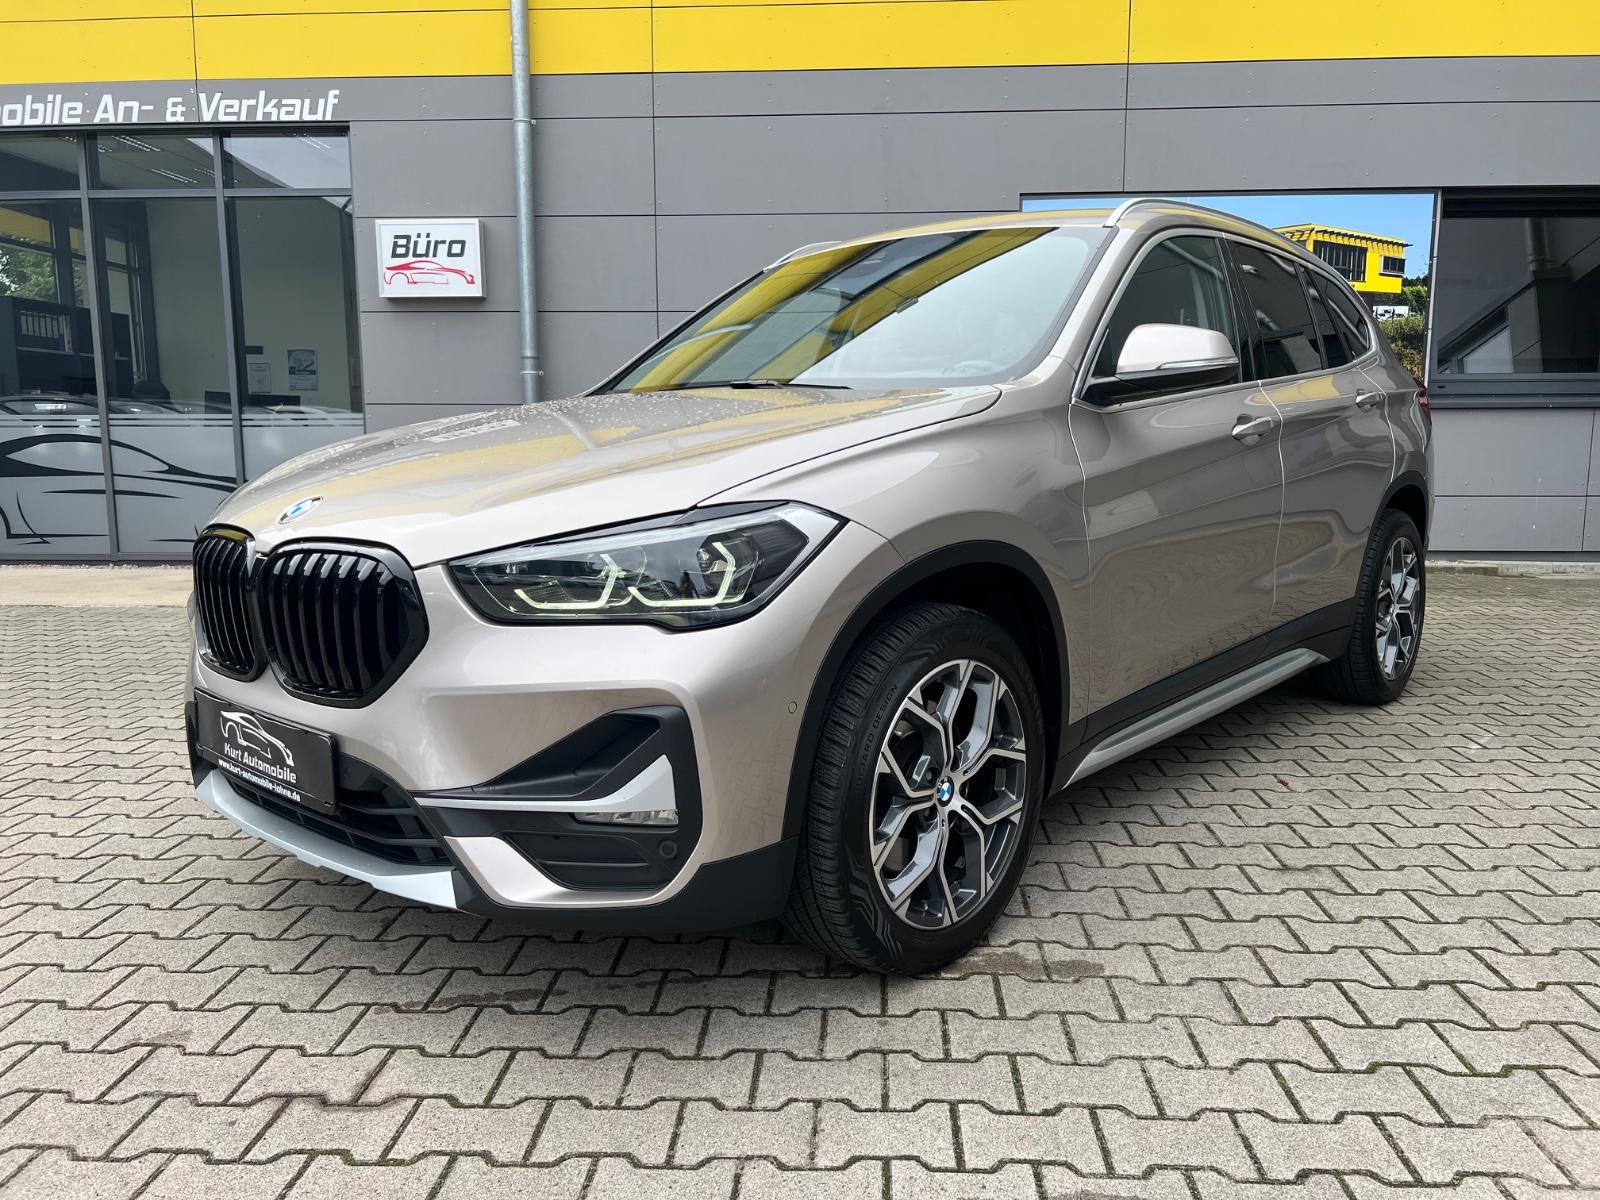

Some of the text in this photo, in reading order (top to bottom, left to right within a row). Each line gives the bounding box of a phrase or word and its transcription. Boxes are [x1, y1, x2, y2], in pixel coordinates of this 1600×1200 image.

[0, 89, 340, 126] obile An- & Verkauf
[391, 232, 467, 259] Büro
[224, 742, 297, 783] Kurt Automobile
